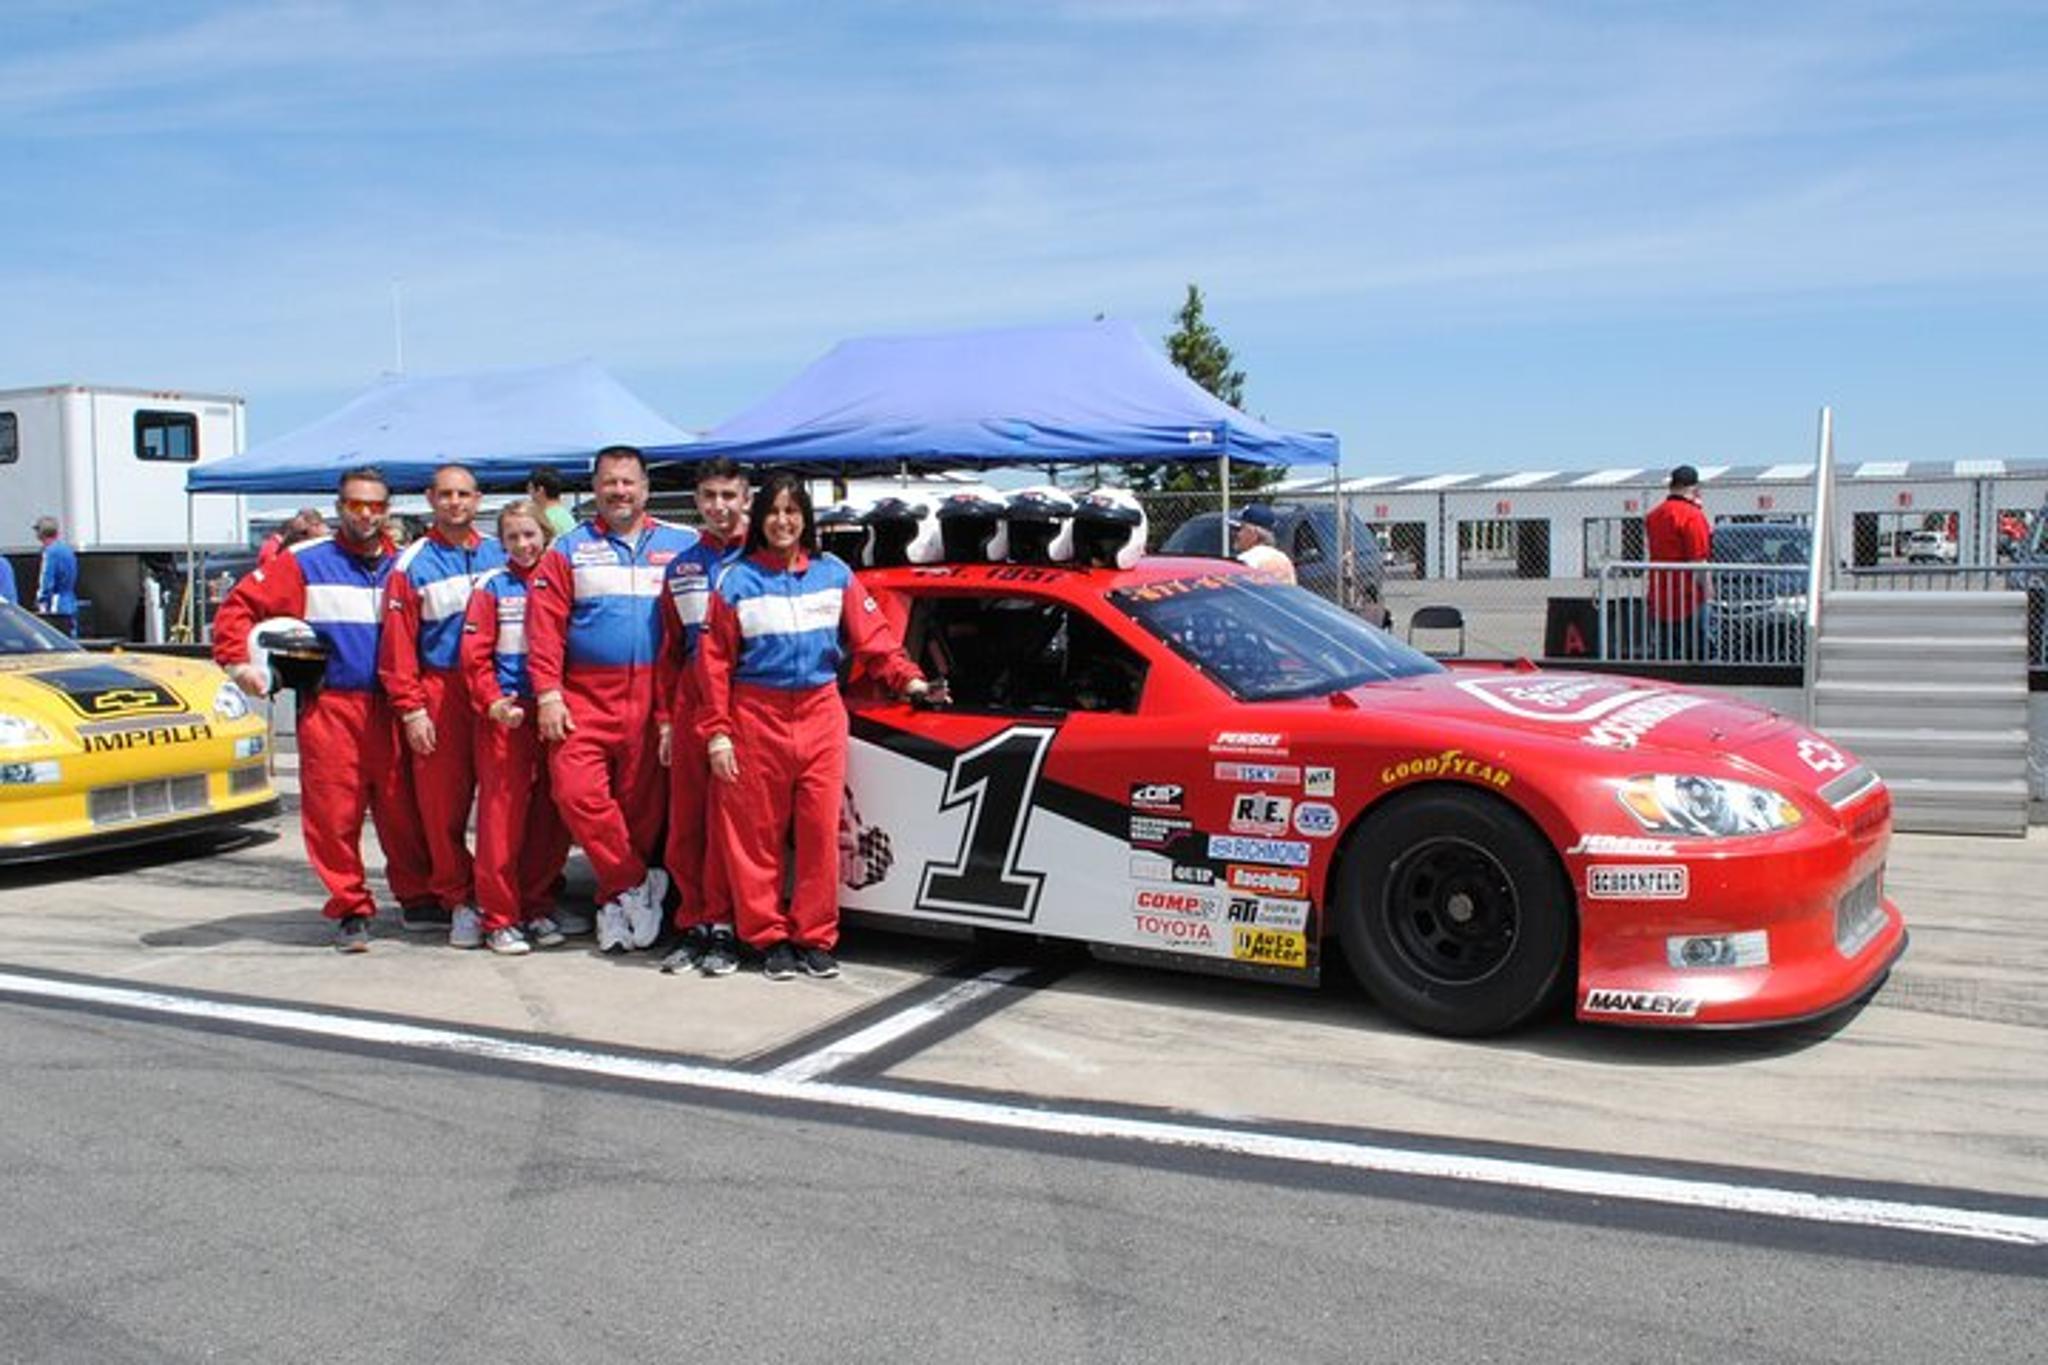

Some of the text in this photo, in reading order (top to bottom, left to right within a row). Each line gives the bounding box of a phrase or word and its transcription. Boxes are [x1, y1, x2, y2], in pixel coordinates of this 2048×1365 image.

[1565, 622, 1586, 655] A
[83, 724, 212, 753] IMPALA
[1240, 766, 1278, 781] ISKY
[1381, 749, 1512, 788] GOODYEAR
[914, 726, 1056, 924] 1
[1233, 838, 1308, 864] RICHMOND
[1137, 892, 1200, 911] COMP
[1134, 916, 1212, 939] TOYOTA
[1256, 932, 1296, 947] Auto
[1251, 946, 1302, 962] Meter
[1589, 992, 1678, 1013] MANLEY
